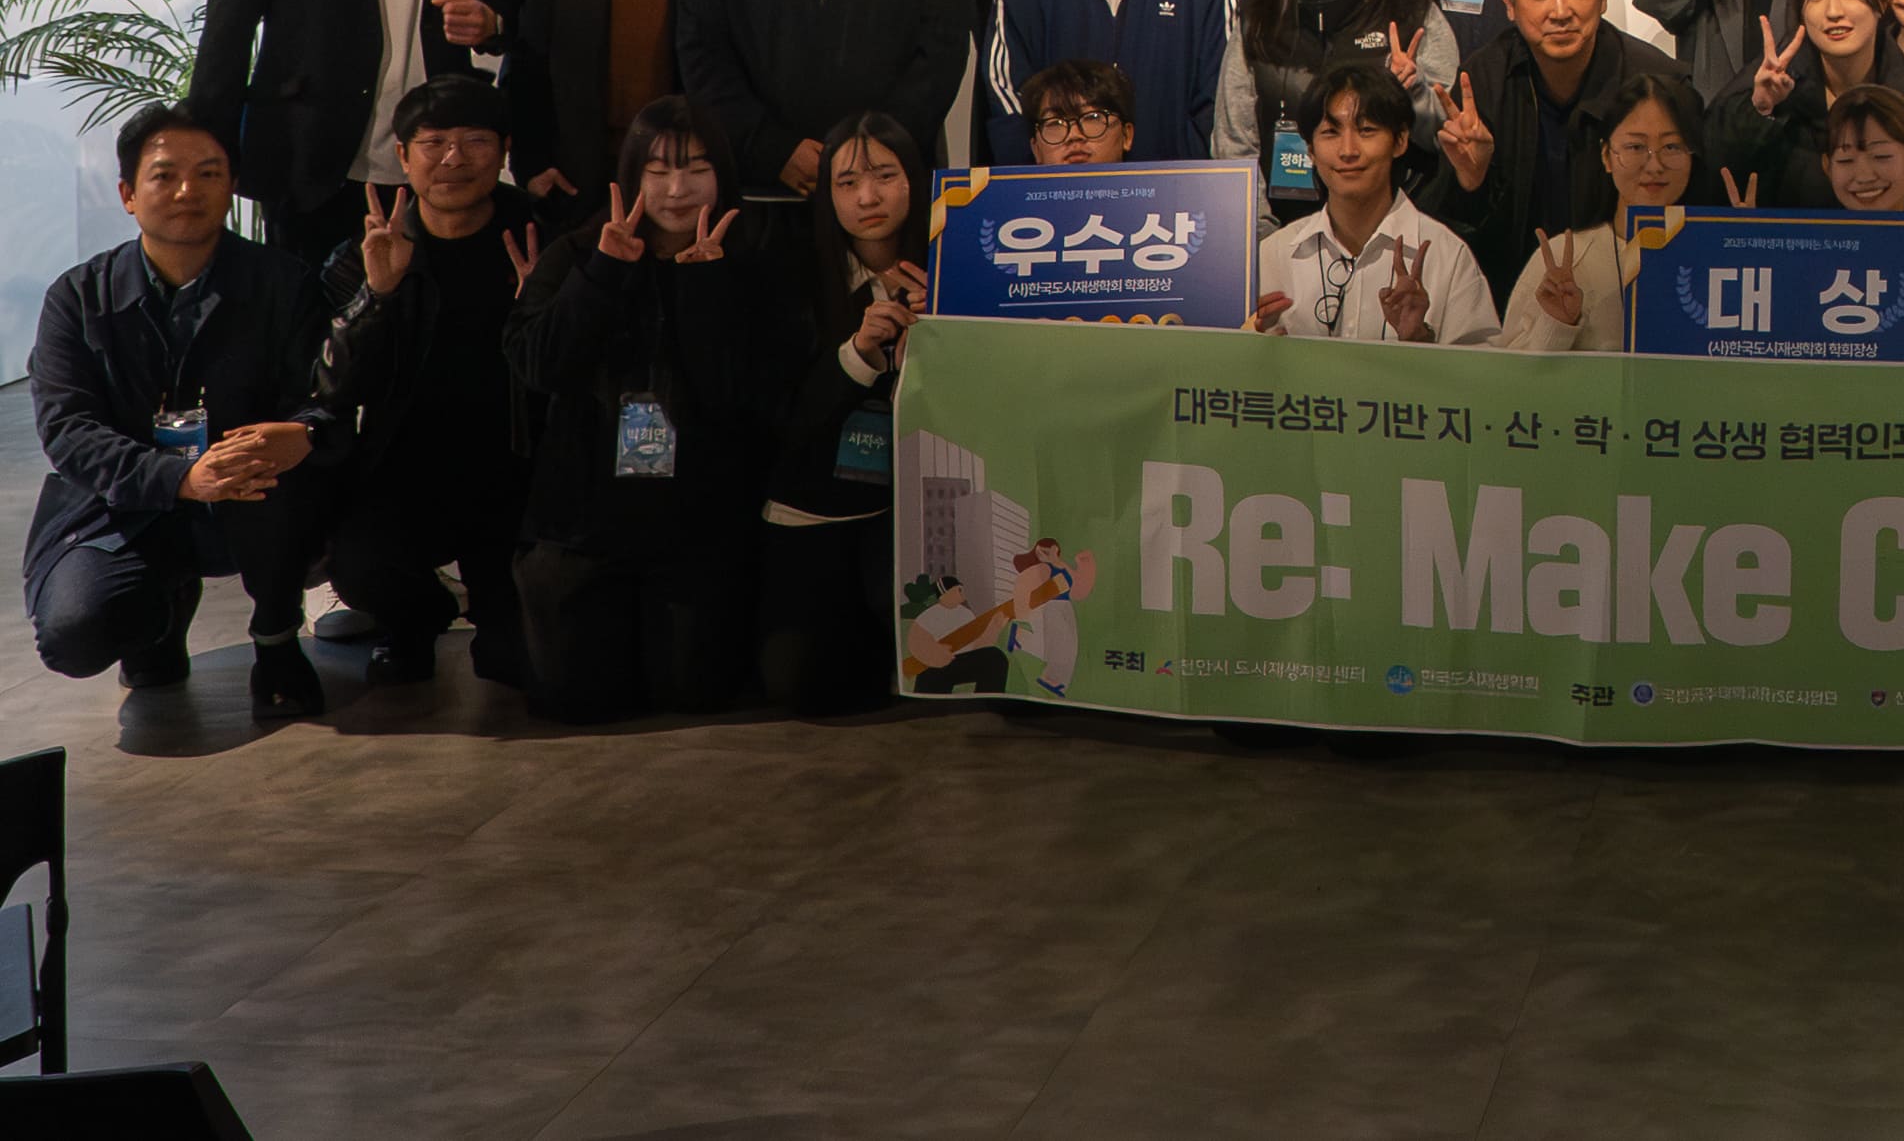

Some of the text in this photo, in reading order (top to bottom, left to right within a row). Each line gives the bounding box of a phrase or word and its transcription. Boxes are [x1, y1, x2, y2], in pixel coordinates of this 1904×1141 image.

[994, 212, 1195, 276] 우수상
[1008, 278, 1173, 298] (사)한국도시재생학회 학회장상
[1708, 341, 1878, 358] (사)한국도시재생학회 학회장상
[1174, 387, 1347, 435] 대학특성화
[1356, 400, 1428, 441] 기반
[1437, 407, 1472, 443] 지
[1505, 410, 1542, 450] 산
[1574, 414, 1613, 455] 학
[1644, 418, 1681, 458] 연
[1692, 420, 1768, 460] 상생
[1140, 460, 1352, 620] Re:
[1401, 476, 1793, 648] Make
[1104, 650, 1145, 672] 주최
[1180, 659, 1366, 684] 천안시 도시재생지원센터
[1571, 683, 1615, 707] 주관
